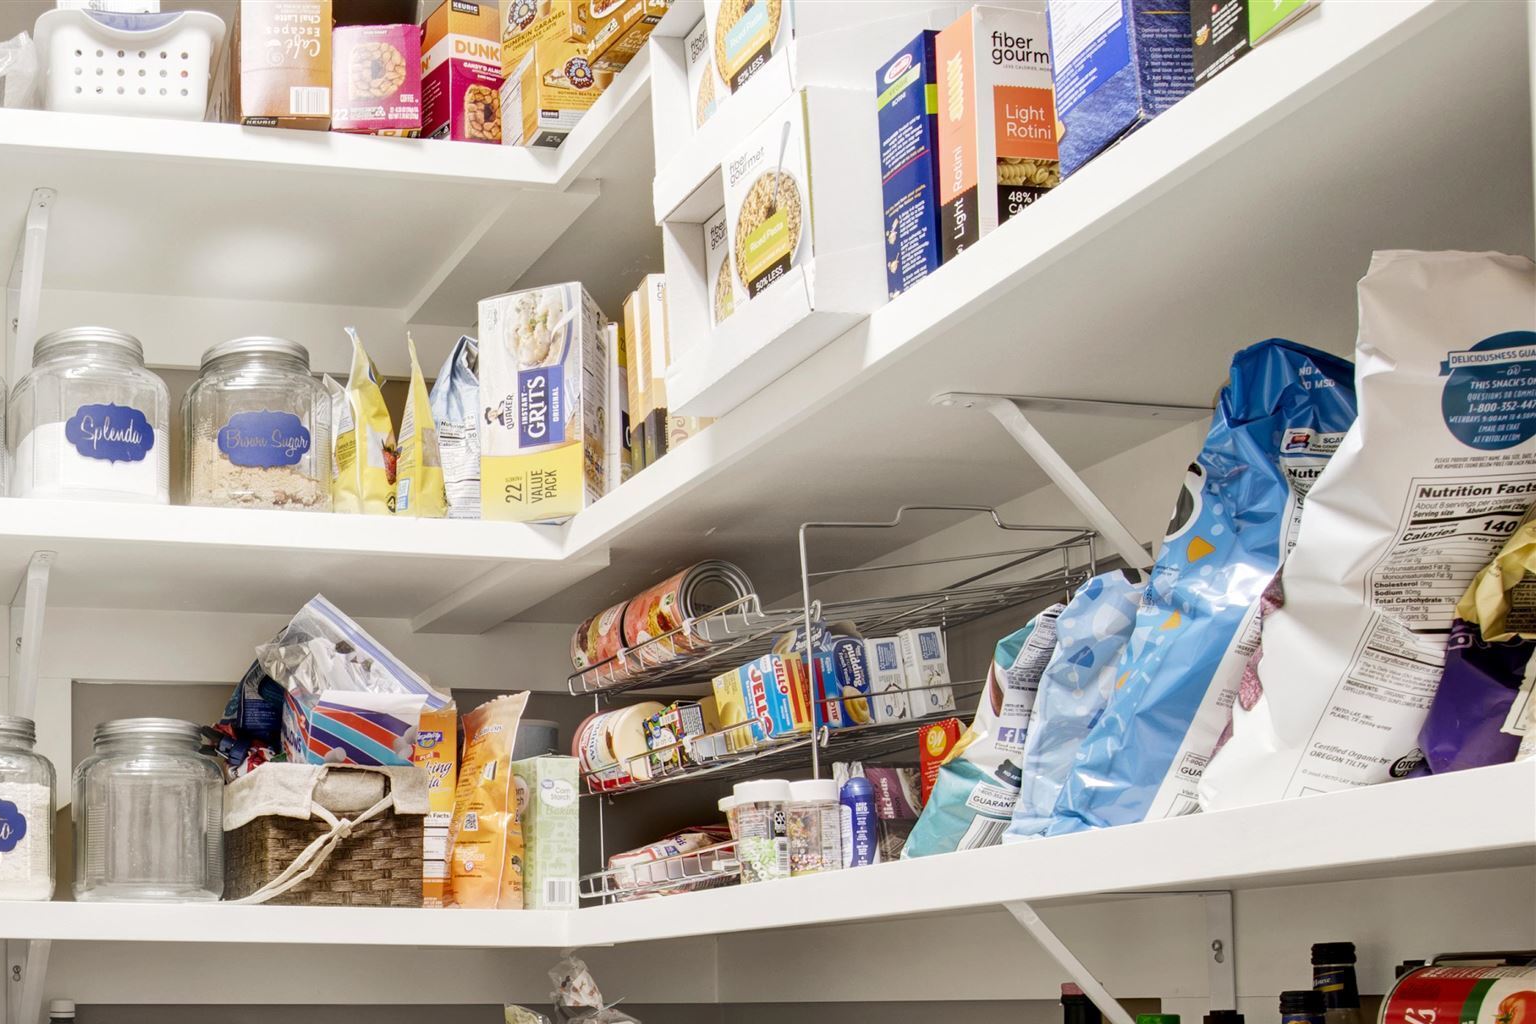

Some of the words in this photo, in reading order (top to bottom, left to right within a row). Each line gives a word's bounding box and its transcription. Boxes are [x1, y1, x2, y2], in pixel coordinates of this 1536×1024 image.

[453, 1, 479, 13] KEURIG
[266, 26, 321, 38] Escapes
[503, 27, 533, 51] PUMPKIN
[534, 10, 566, 32] CARAMEL
[991, 31, 1034, 50] fiber
[1005, 103, 1046, 122] Light
[1007, 122, 1052, 141] Rotini
[952, 145, 964, 194] Rotini
[1008, 191, 1033, 203] 48%
[954, 197, 967, 241] Light
[1451, 350, 1518, 365] DELICIOUSNESS
[506, 394, 514, 431] QUAKER
[527, 375, 547, 439] GRITS
[552, 386, 560, 422] ORIGINAL
[80, 414, 143, 449] Splenda
[225, 429, 266, 450] Brown
[271, 429, 309, 457] Sugar
[505, 483, 522, 504] 22
[530, 469, 544, 504] VALUE
[544, 470, 558, 498] PACK
[1419, 486, 1493, 499] Nutrition
[1444, 500, 1477, 511] servings
[1402, 528, 1458, 542] Calories
[1483, 520, 1518, 533] 140
[1374, 580, 1419, 589] Cholesterol
[1374, 589, 1403, 597] Sodium
[1395, 597, 1443, 605] Carbohydrate
[843, 643, 864, 688] pudding
[1310, 750, 1345, 765] OREGON
[1345, 758, 1369, 770] TILTH
[1314, 741, 1348, 756] Certified
[1348, 749, 1378, 763] Organic
[550, 792, 571, 801] Starch
[554, 787, 571, 795] Corn
